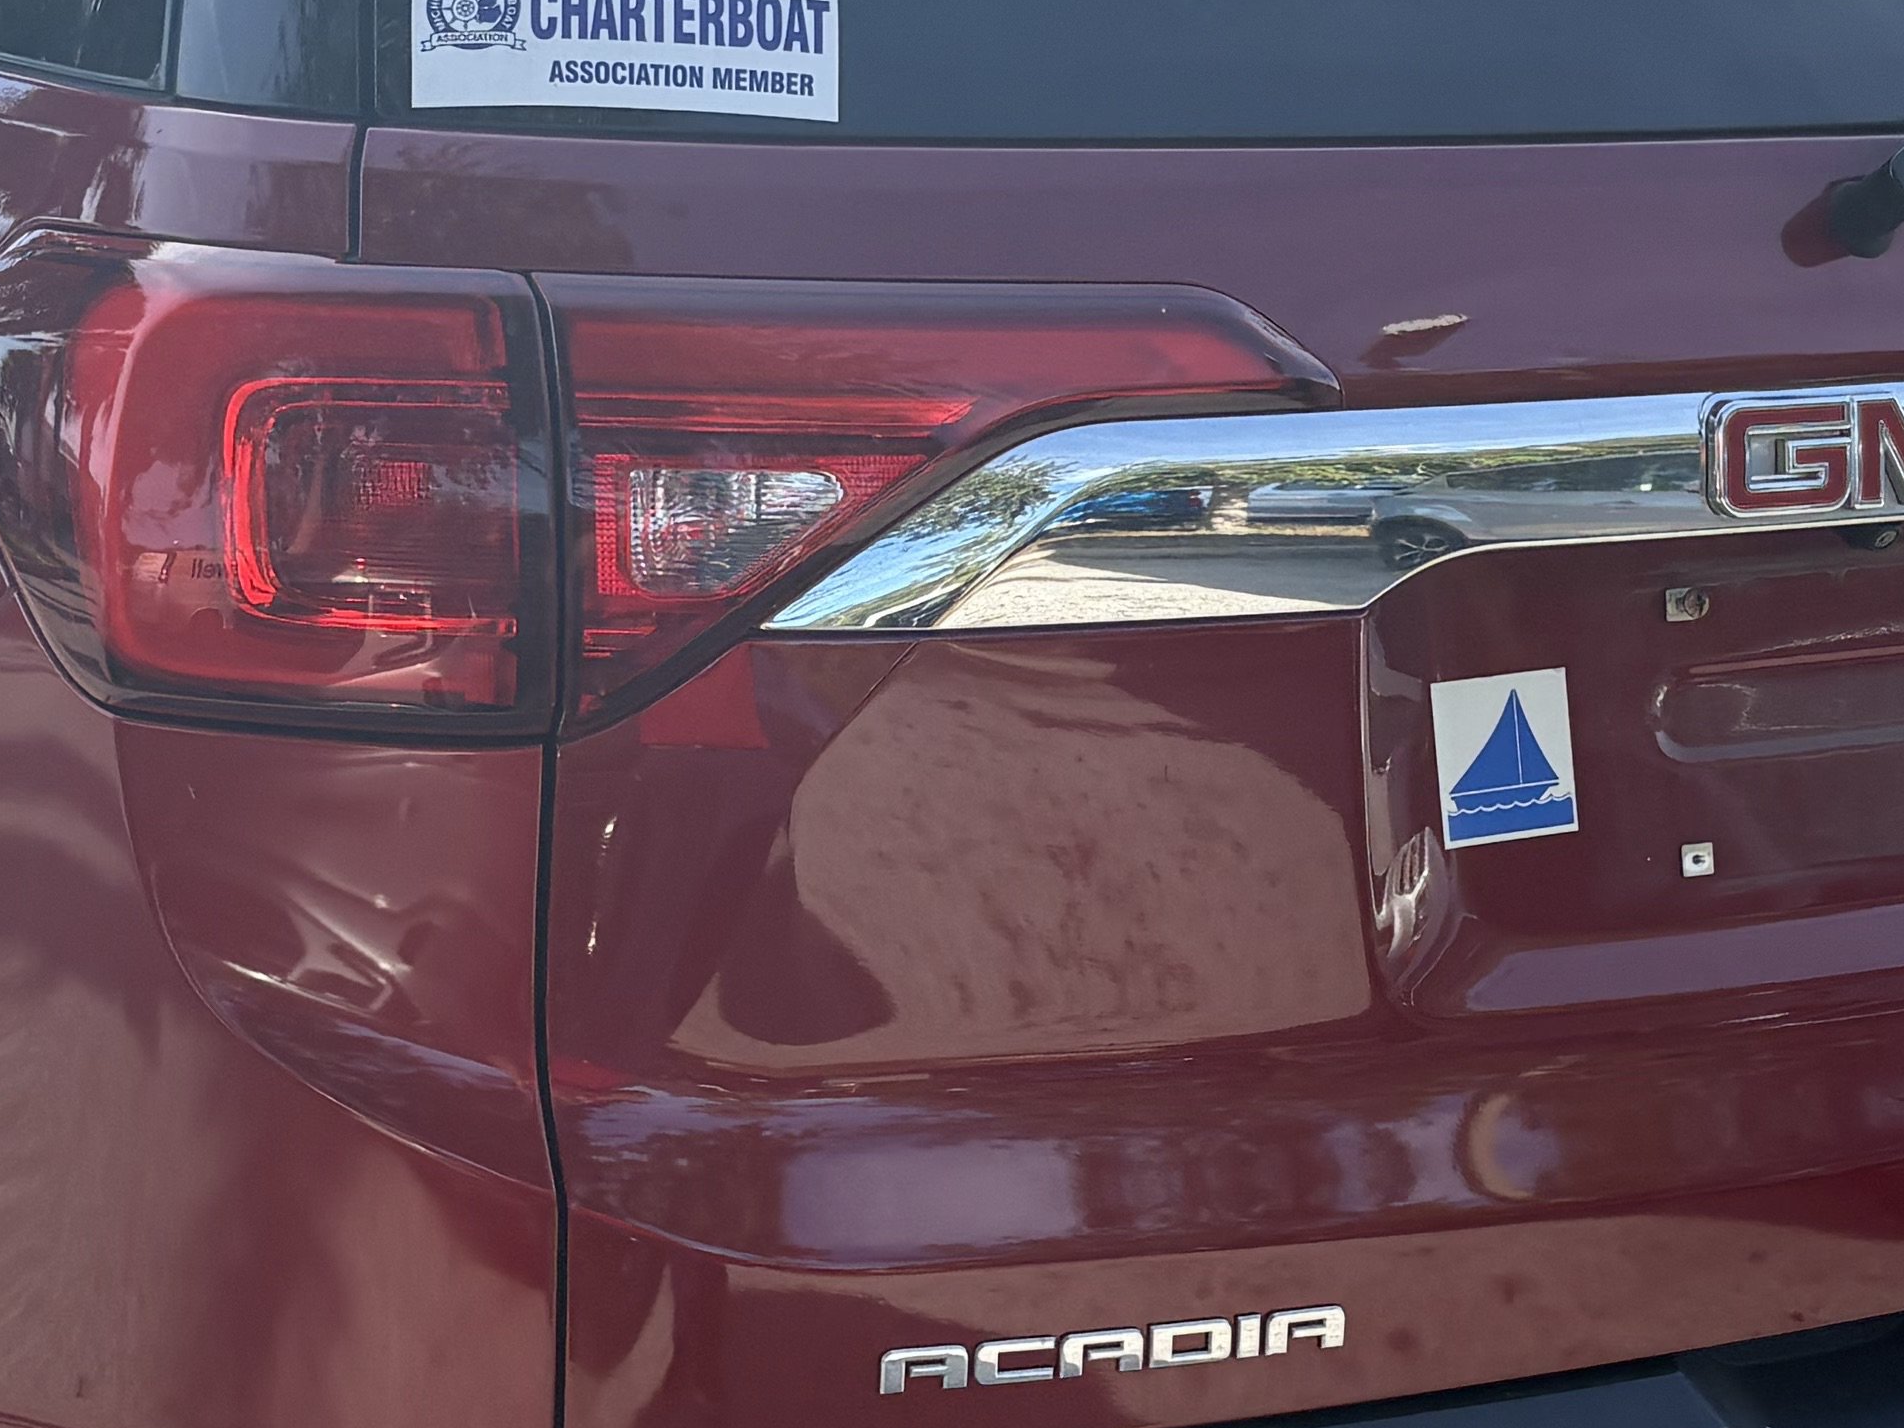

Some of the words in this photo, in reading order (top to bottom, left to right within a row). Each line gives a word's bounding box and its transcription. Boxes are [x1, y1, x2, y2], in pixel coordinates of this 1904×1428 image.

[437, 33, 509, 43] ASSOCIATION
[549, 60, 703, 89] ASSOCIATION
[712, 67, 815, 97] MEMBER
[879, 1304, 1346, 1395] ACADIA
